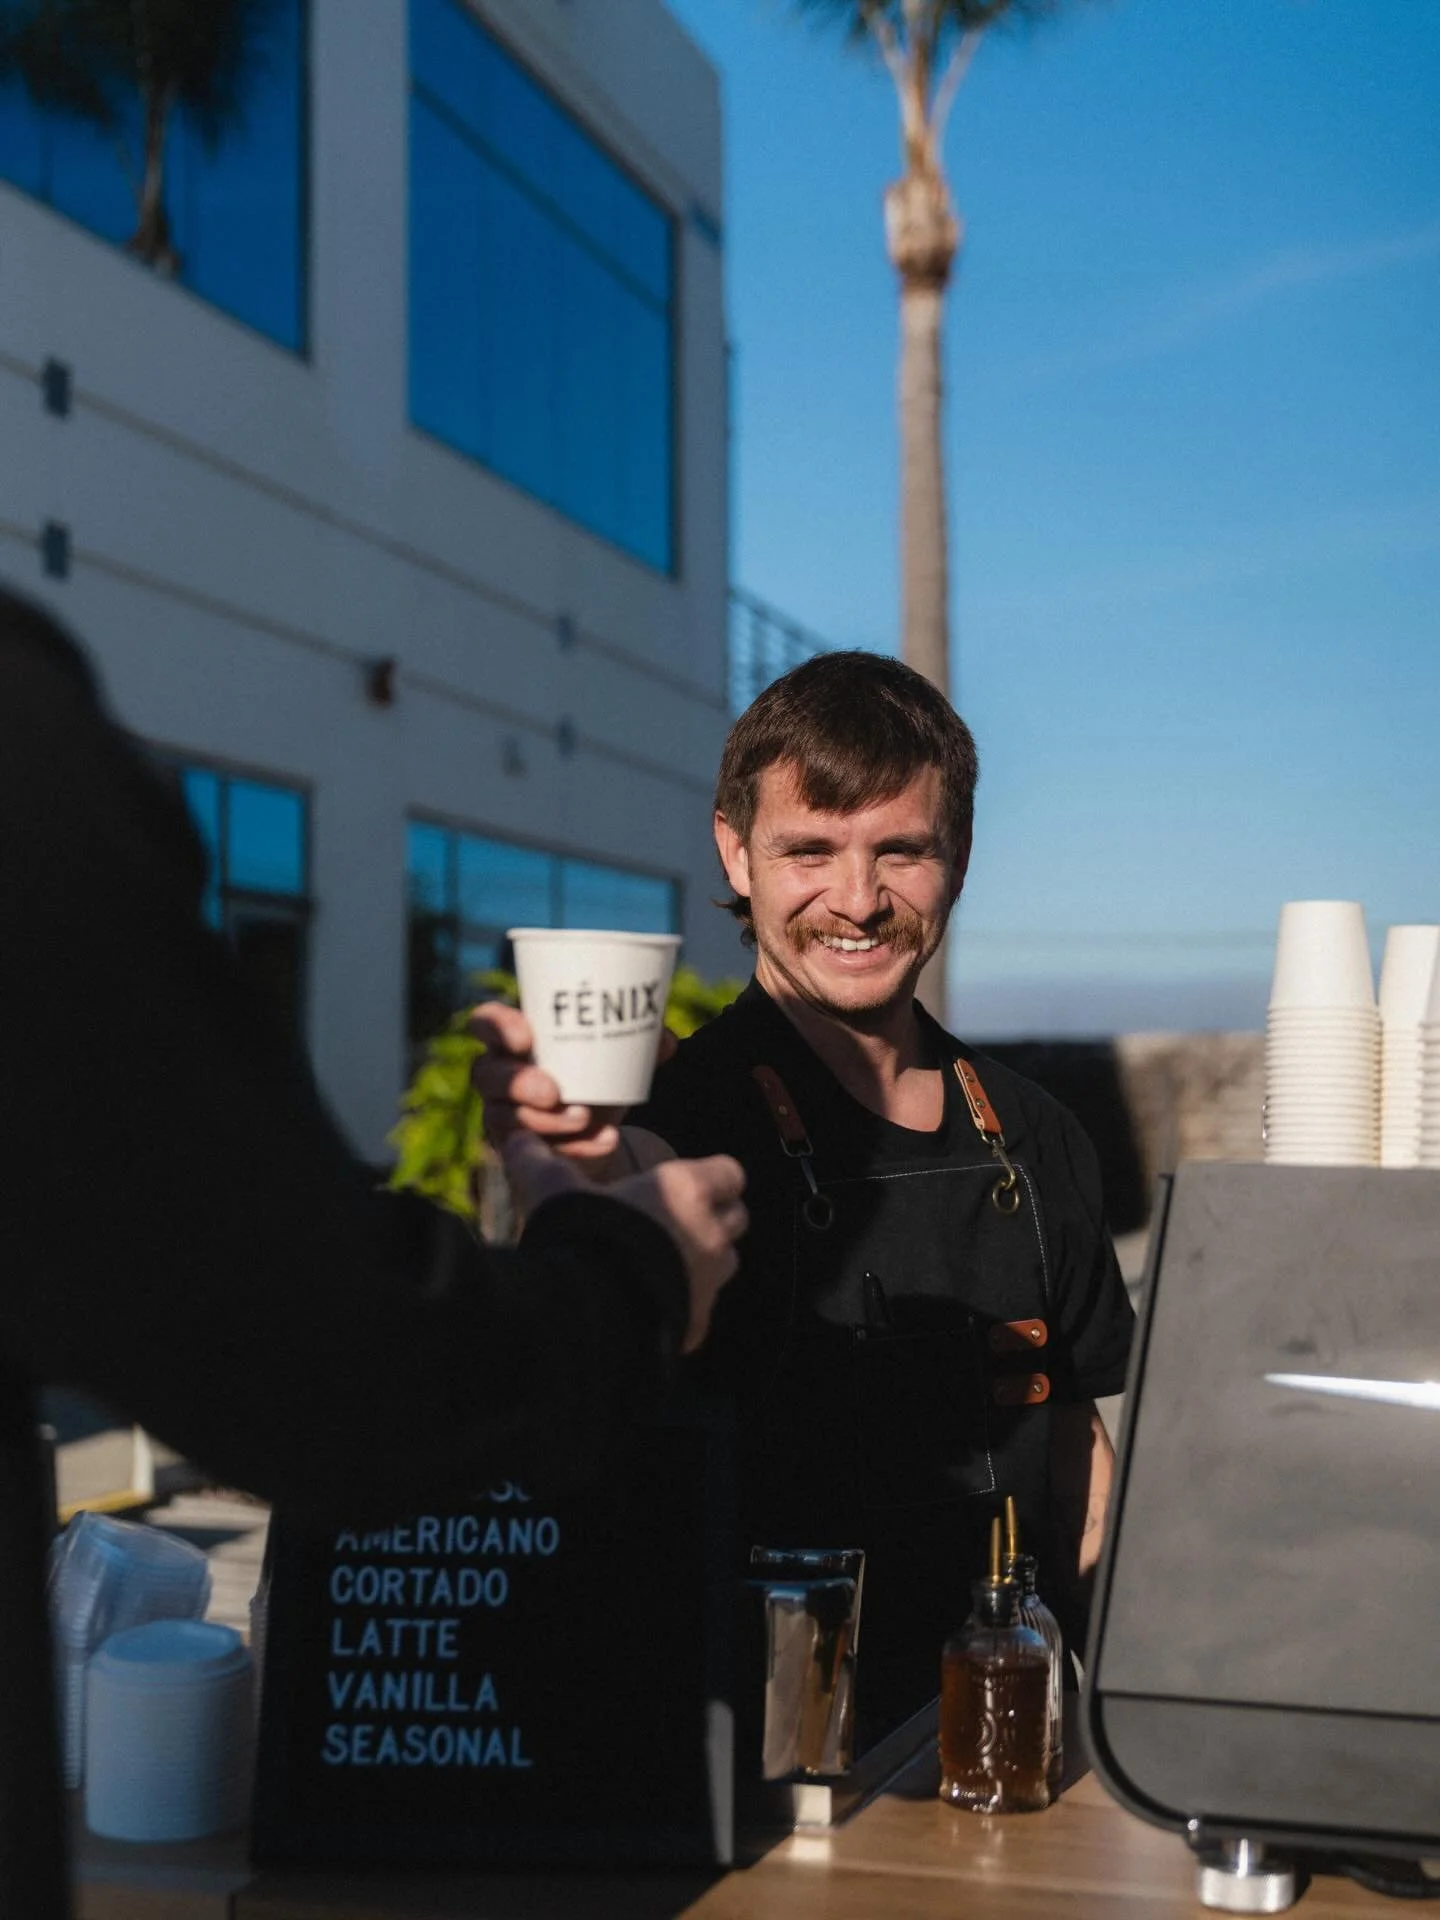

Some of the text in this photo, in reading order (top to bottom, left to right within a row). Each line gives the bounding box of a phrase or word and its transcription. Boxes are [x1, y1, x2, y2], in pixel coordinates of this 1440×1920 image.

[335, 1515, 560, 1555] AMERICANO
[330, 1565, 509, 1607] CORTADO
[331, 1617, 461, 1658] LATTE
[327, 1670, 499, 1712] VANILLA
[321, 1723, 533, 1768] SEASONAL
